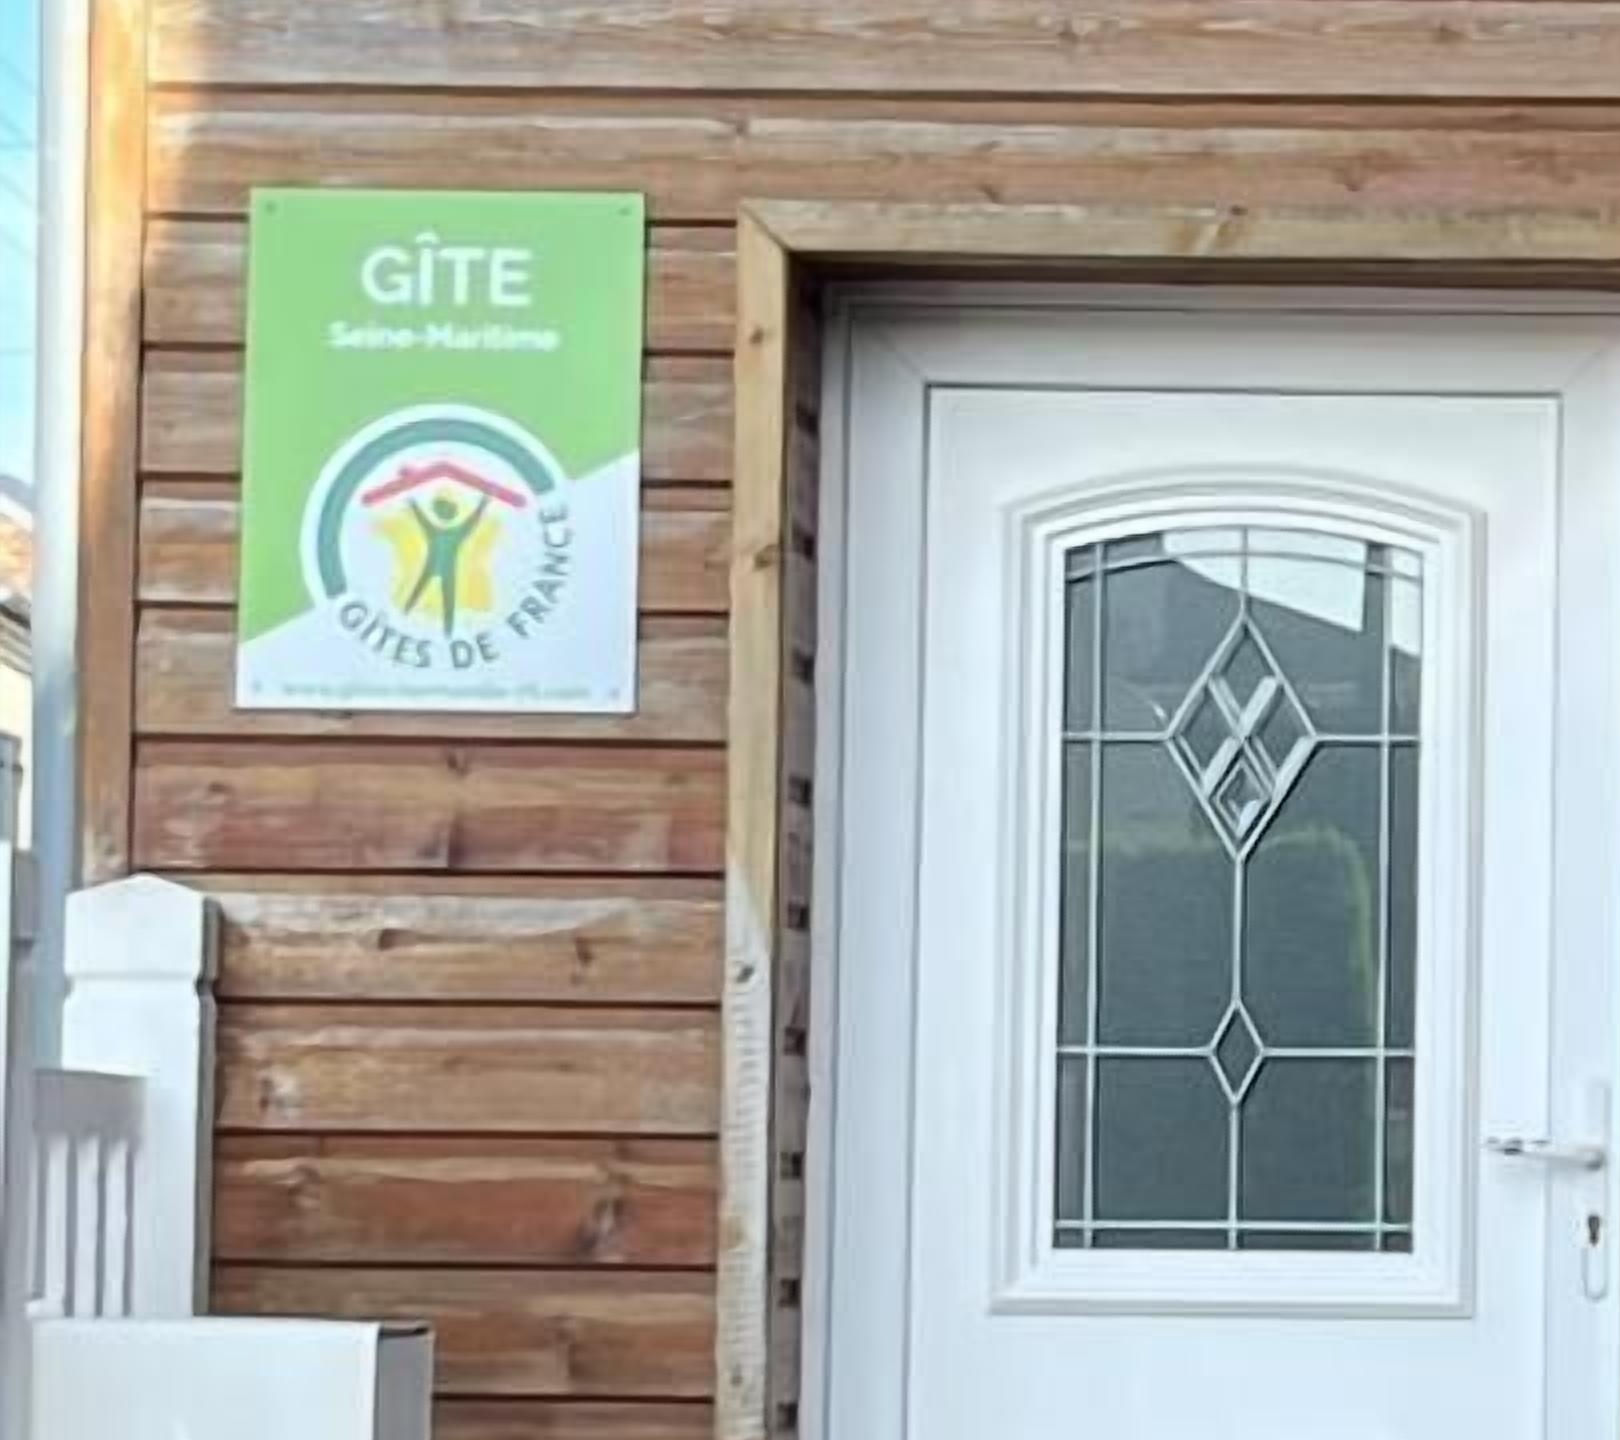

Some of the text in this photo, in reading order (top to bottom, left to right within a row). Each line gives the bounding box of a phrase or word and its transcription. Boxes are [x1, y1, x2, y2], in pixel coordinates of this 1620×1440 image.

[360, 231, 533, 308] GÎTE
[451, 632, 500, 669] DE
[506, 502, 576, 639] FRANCE
